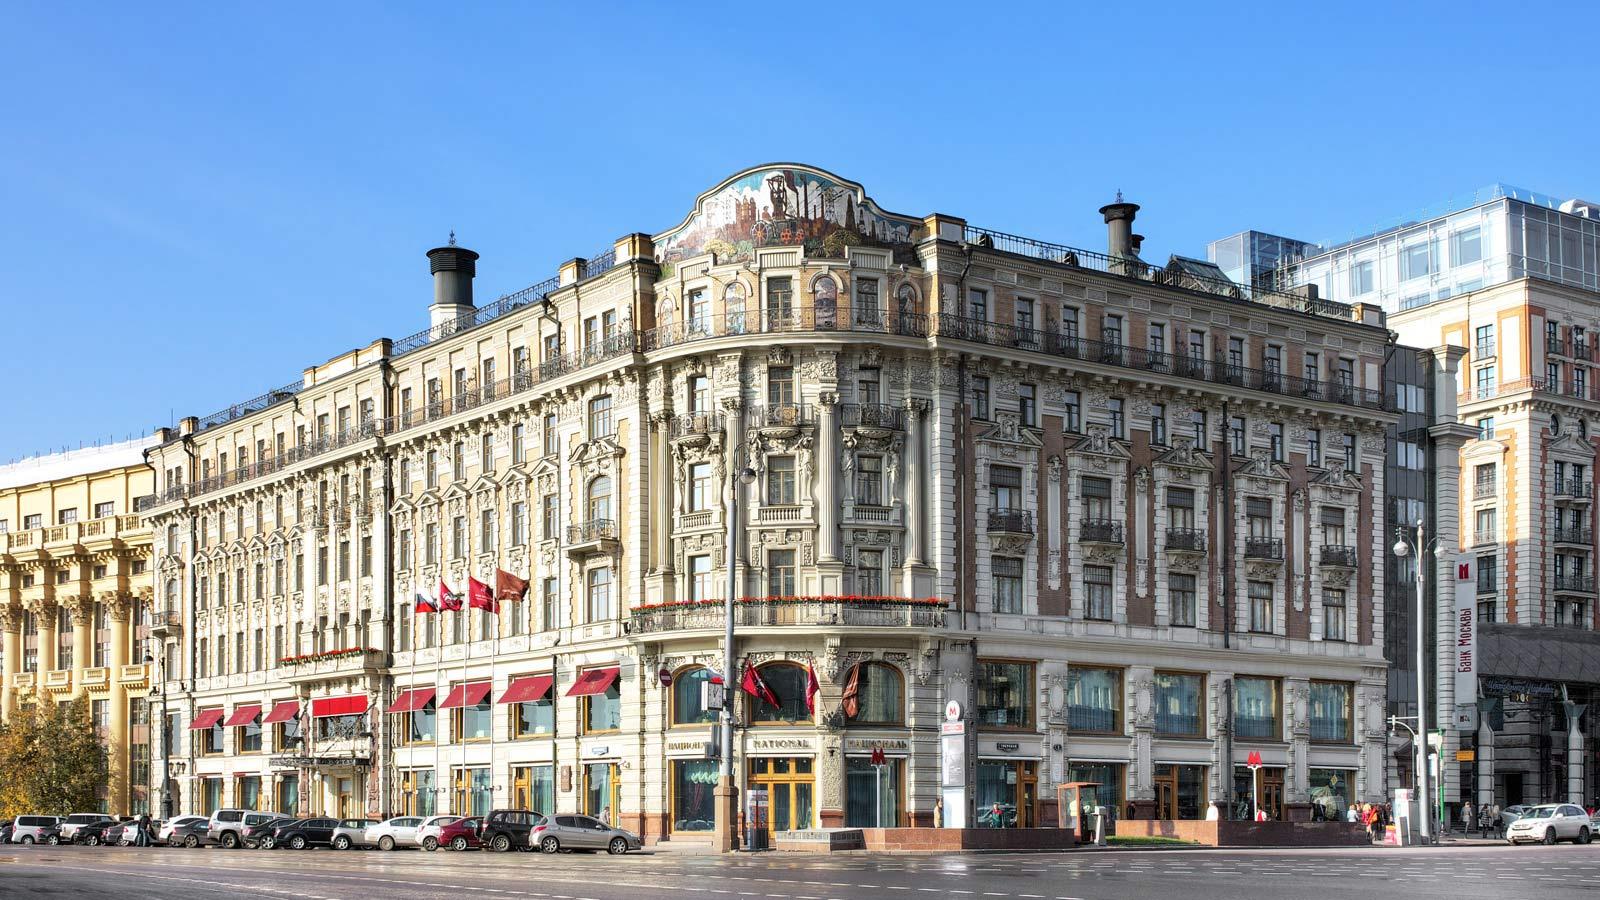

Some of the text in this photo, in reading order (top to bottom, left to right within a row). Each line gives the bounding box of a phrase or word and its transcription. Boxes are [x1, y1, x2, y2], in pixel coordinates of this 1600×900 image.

[1457, 608, 1472, 673] Банк Москвы
[753, 739, 809, 749] NATIONAL
[847, 739, 907, 749] НАЦИОНАЛЬ
